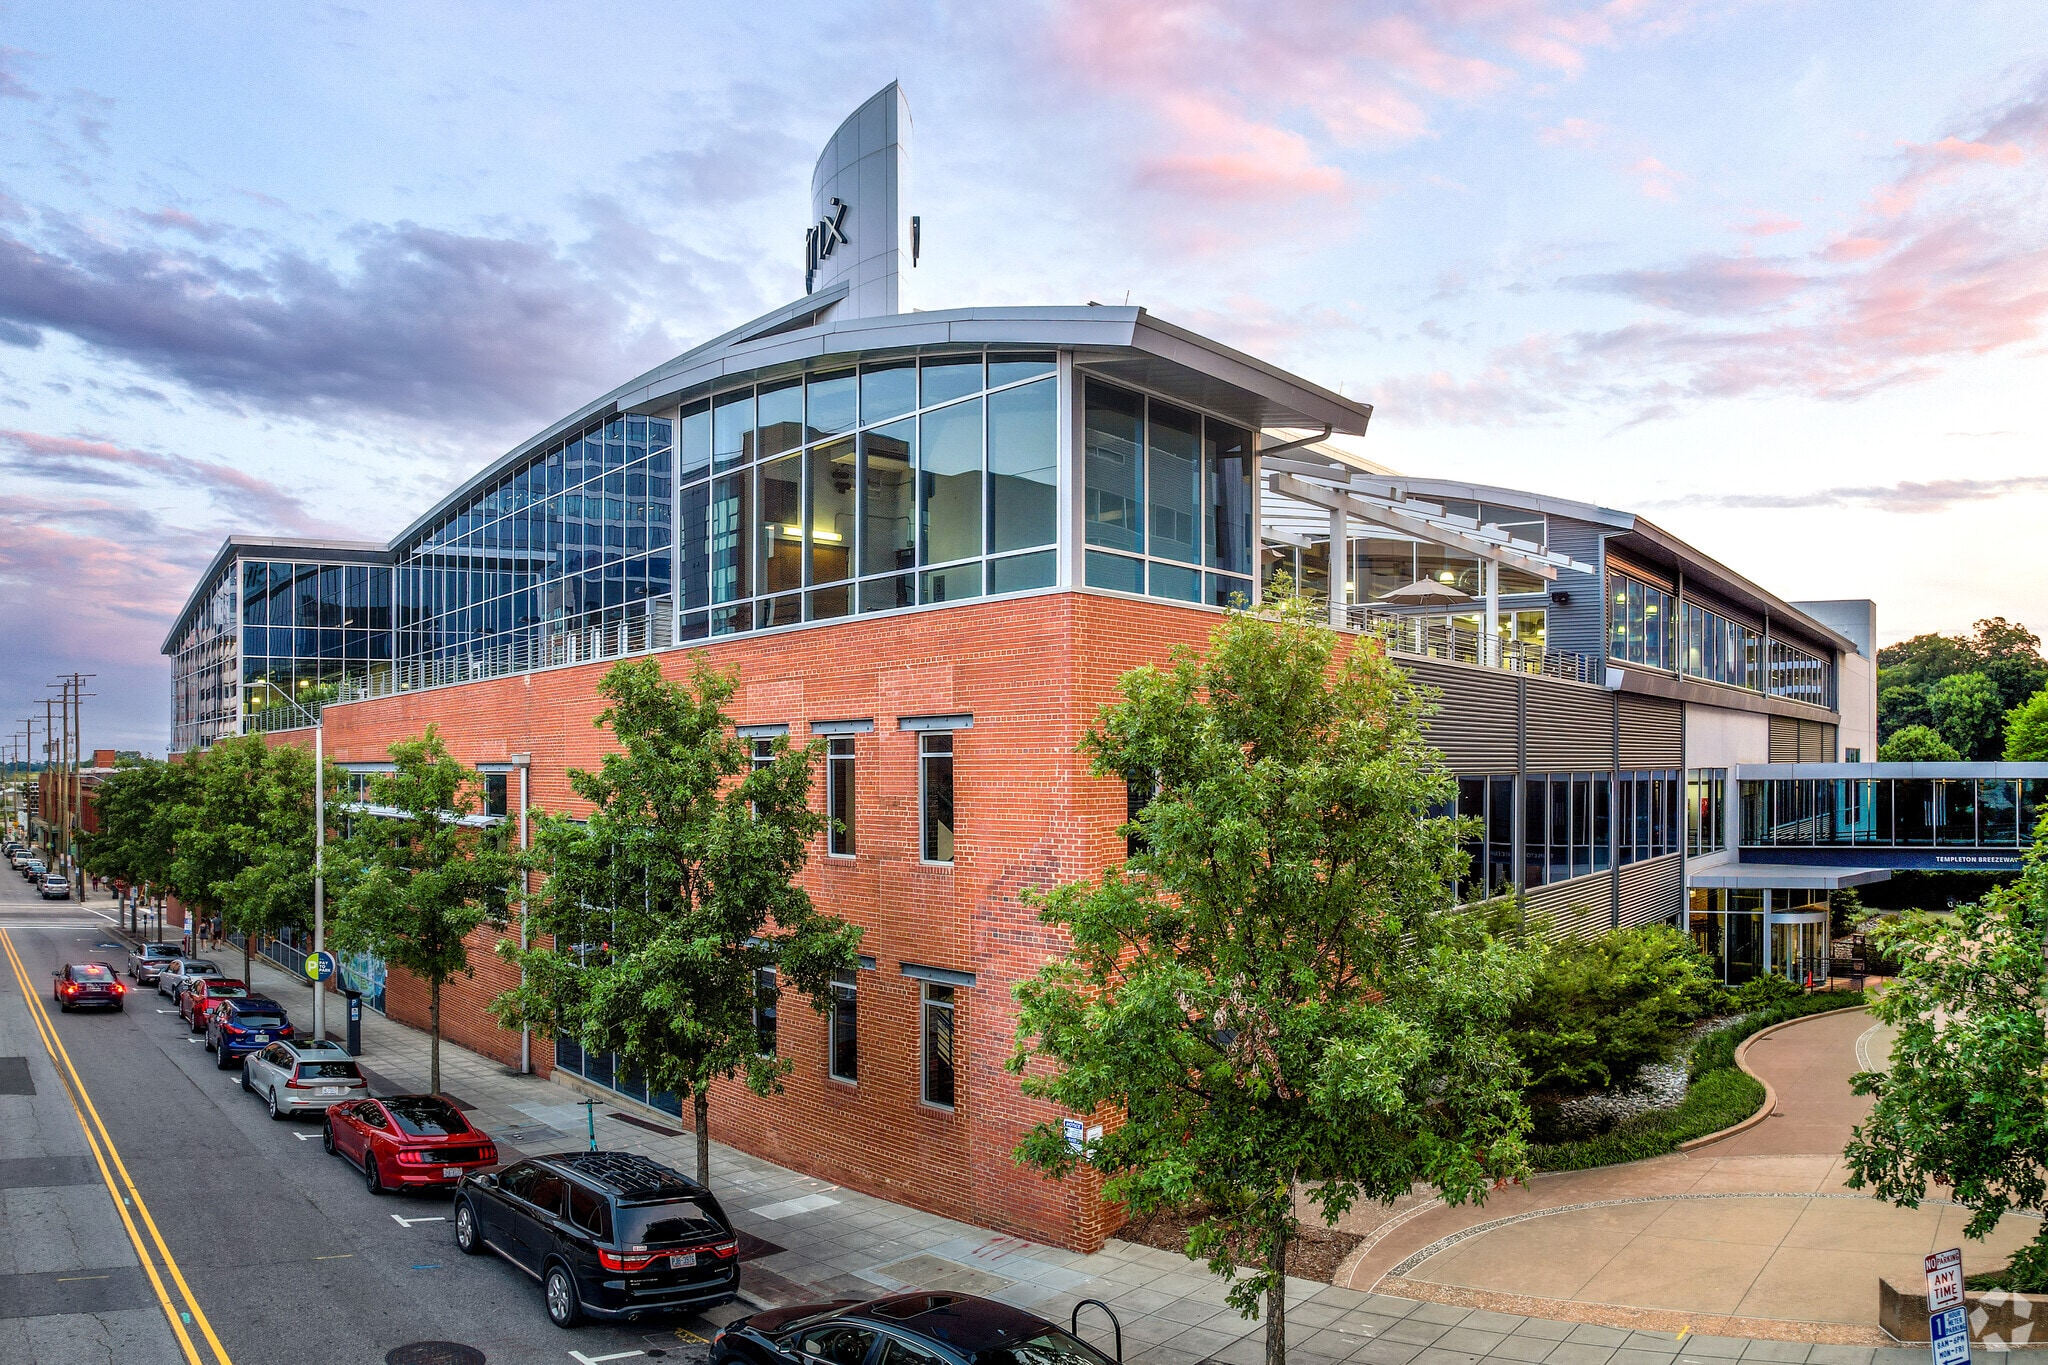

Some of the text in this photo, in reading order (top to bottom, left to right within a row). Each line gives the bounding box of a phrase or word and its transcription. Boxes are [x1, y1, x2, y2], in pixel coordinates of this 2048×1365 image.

[307, 960, 317, 972] P
[1925, 1252, 1960, 1270] NO PARKING
[1935, 1270, 1955, 1286] ANY
[1934, 1283, 1958, 1299] TIME
[1936, 1318, 1942, 1335] 1
[1945, 1323, 1967, 1335] PARKING
